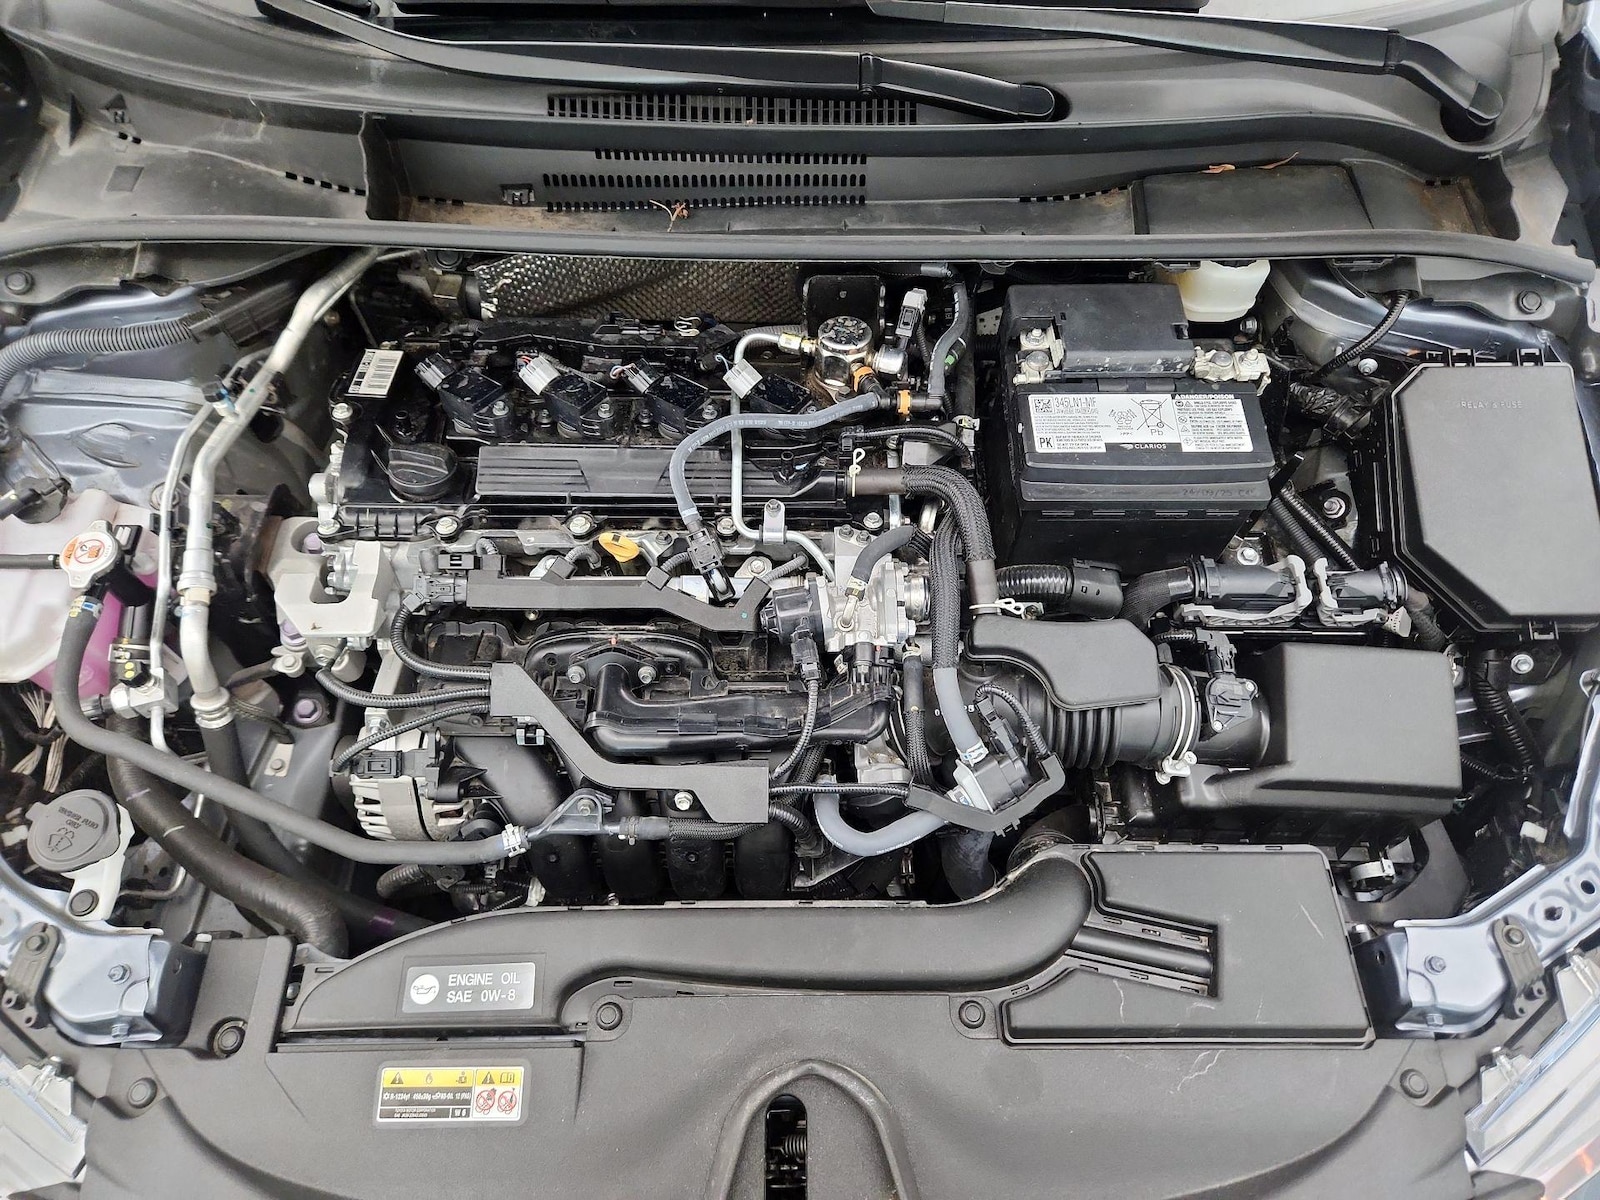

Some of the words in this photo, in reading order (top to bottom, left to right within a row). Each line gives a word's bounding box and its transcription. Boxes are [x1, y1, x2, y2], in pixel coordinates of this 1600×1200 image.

[1460, 400, 1489, 409] RELAY
[1500, 400, 1523, 409] FUSE
[1150, 428, 1164, 436] Pb
[1039, 437, 1053, 448] PK
[448, 972, 493, 987] ENGINE
[501, 972, 521, 984] OIL
[446, 990, 473, 1003] SAE
[480, 989, 516, 1002] 0W-8
